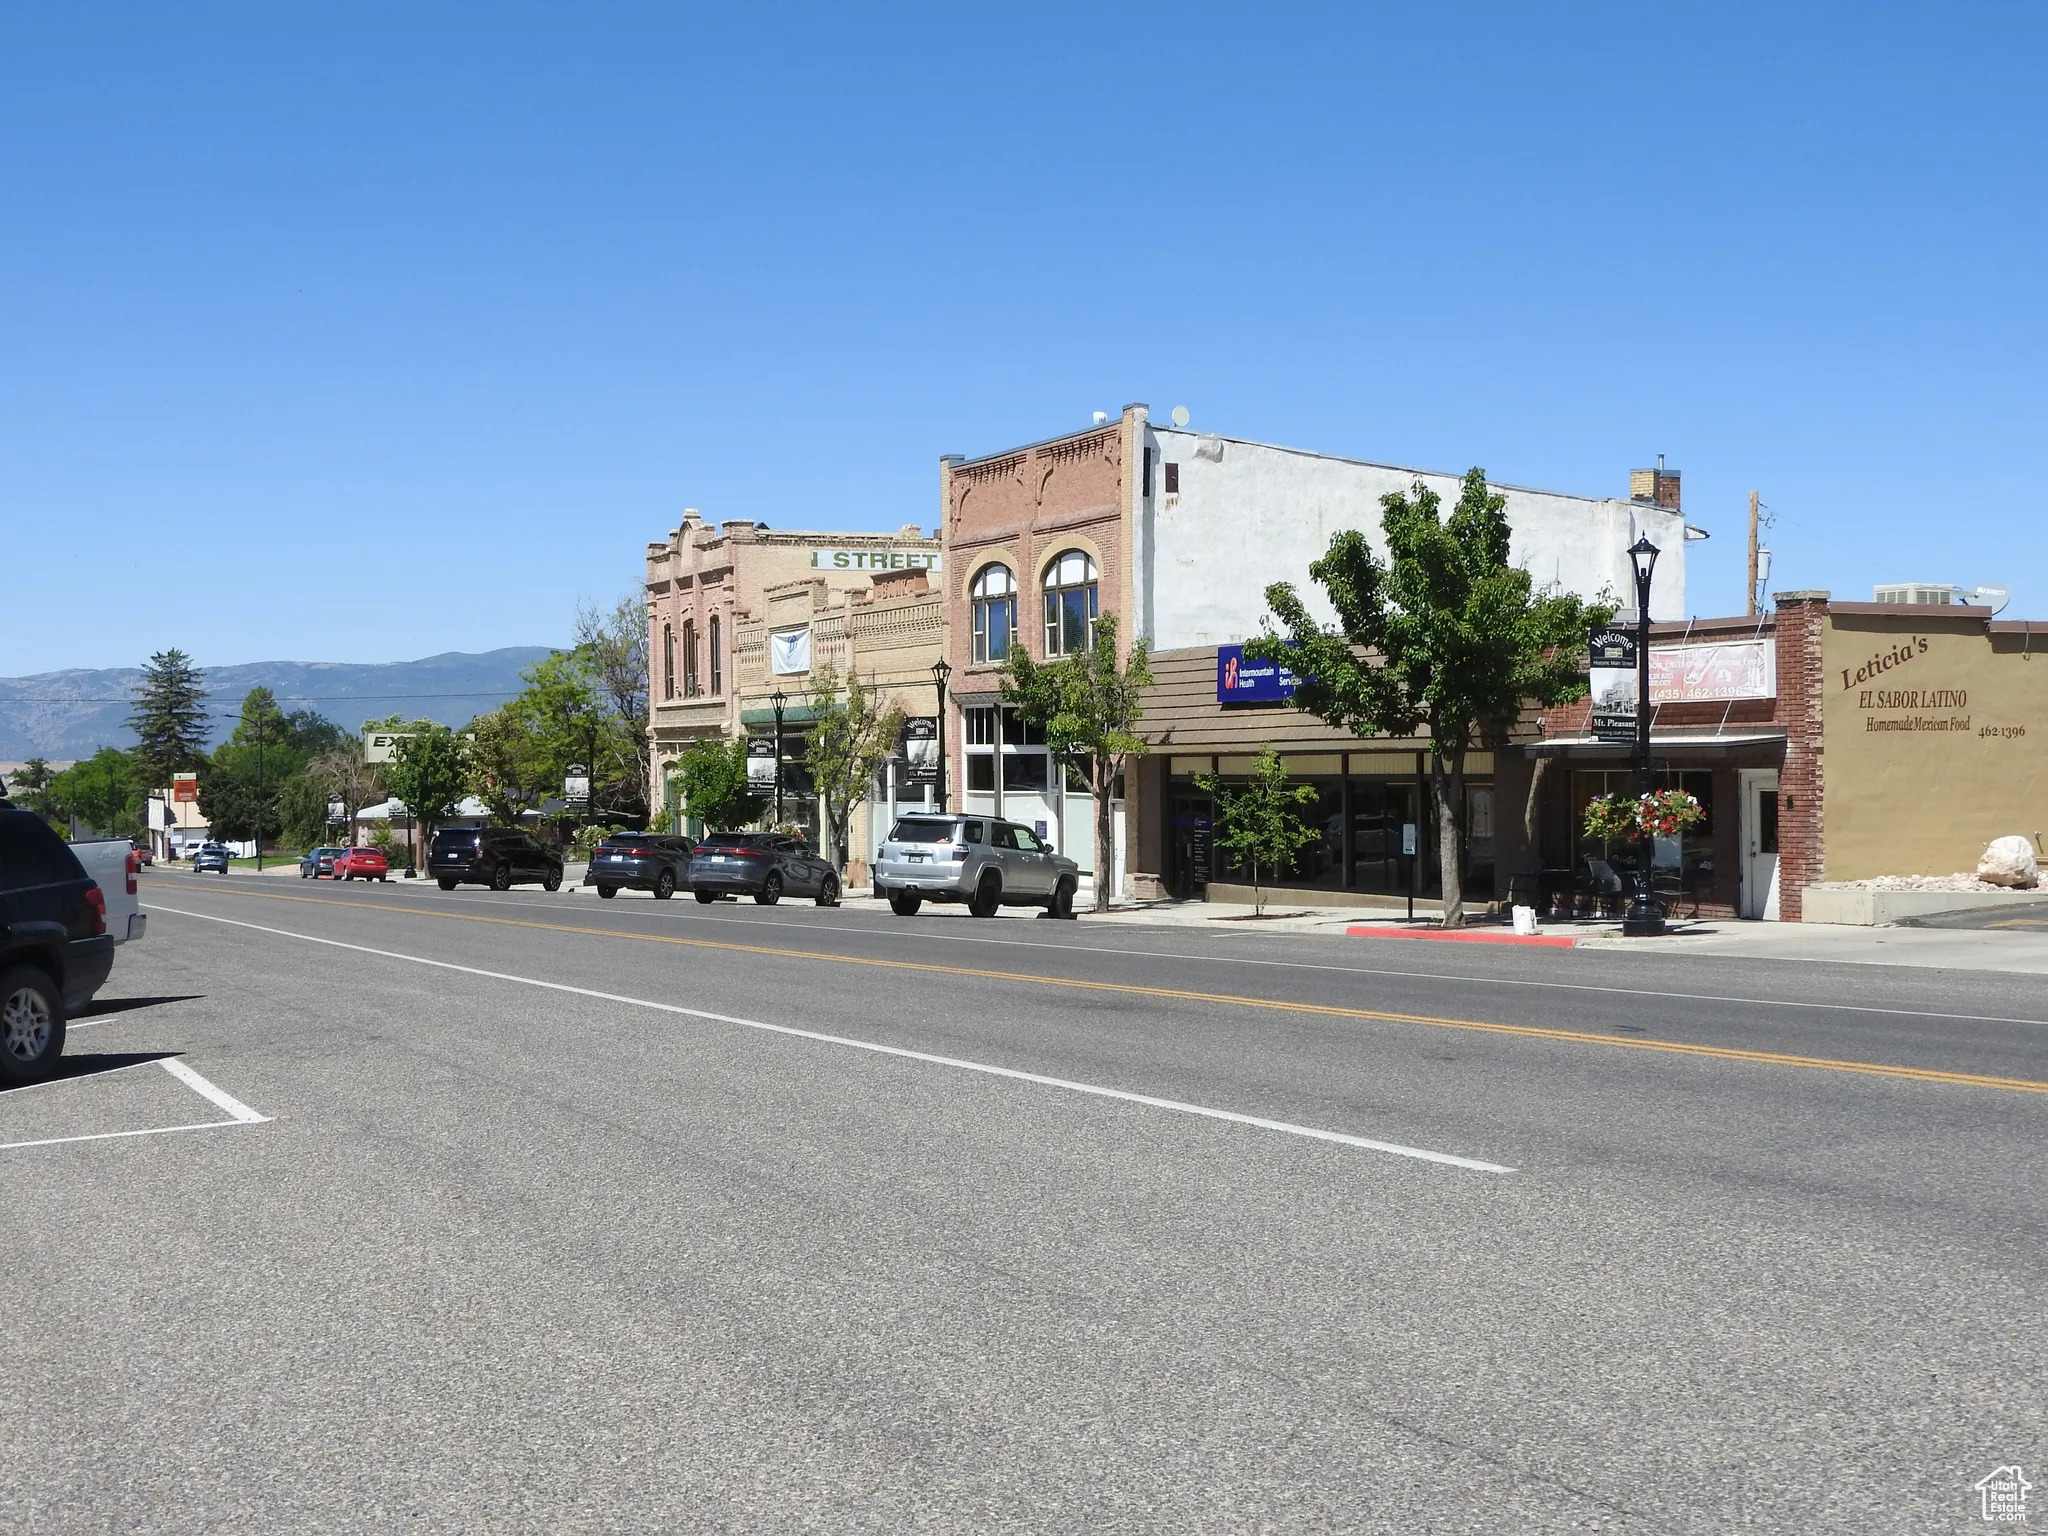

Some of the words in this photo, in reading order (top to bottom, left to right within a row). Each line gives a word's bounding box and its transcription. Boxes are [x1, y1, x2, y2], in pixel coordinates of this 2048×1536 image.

[833, 552, 938, 569] STREET
[1592, 630, 1633, 651] Welcome
[1841, 636, 1929, 690] Leticia's
[1239, 667, 1275, 677] Intermountain
[1239, 679, 1255, 688] Health
[1654, 688, 1684, 700] (435)
[1687, 686, 1742, 698] 462-1396
[1859, 691, 1875, 709] EL
[1876, 690, 1919, 709] SABOR
[1921, 690, 1967, 708] LATINO
[907, 717, 935, 729] Welcome
[1593, 718, 1606, 727] Mt.
[1607, 718, 1636, 728] Pleasant
[1866, 715, 1913, 732] Homemade
[1913, 716, 1948, 732] Mexican
[1950, 716, 1971, 731] Food
